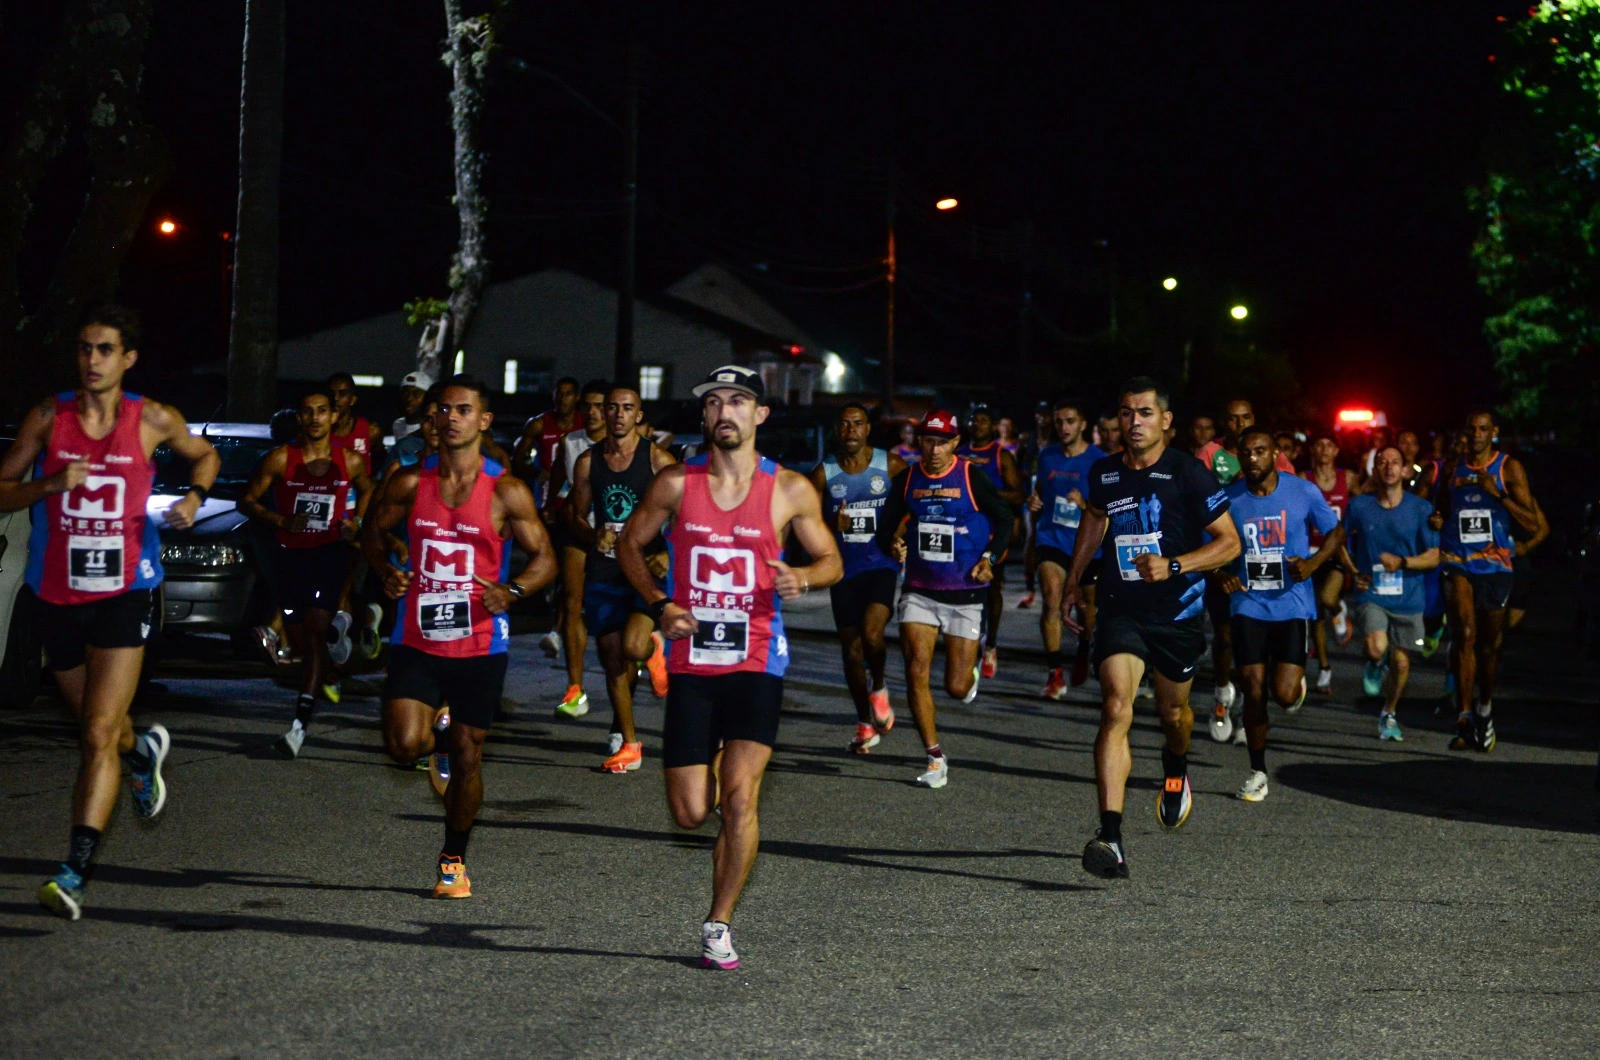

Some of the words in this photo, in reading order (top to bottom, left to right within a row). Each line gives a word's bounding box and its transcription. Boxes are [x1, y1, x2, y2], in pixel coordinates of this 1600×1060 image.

[305, 501, 321, 514] 20
[60, 515, 124, 531] MEGA
[852, 517, 866, 529] 18
[1468, 518, 1482, 529] 14
[929, 533, 943, 547] 21
[85, 550, 107, 568] 11
[1260, 563, 1268, 575] 7
[689, 588, 754, 606] MEGA
[433, 603, 456, 620] 15
[713, 622, 726, 641] 6
